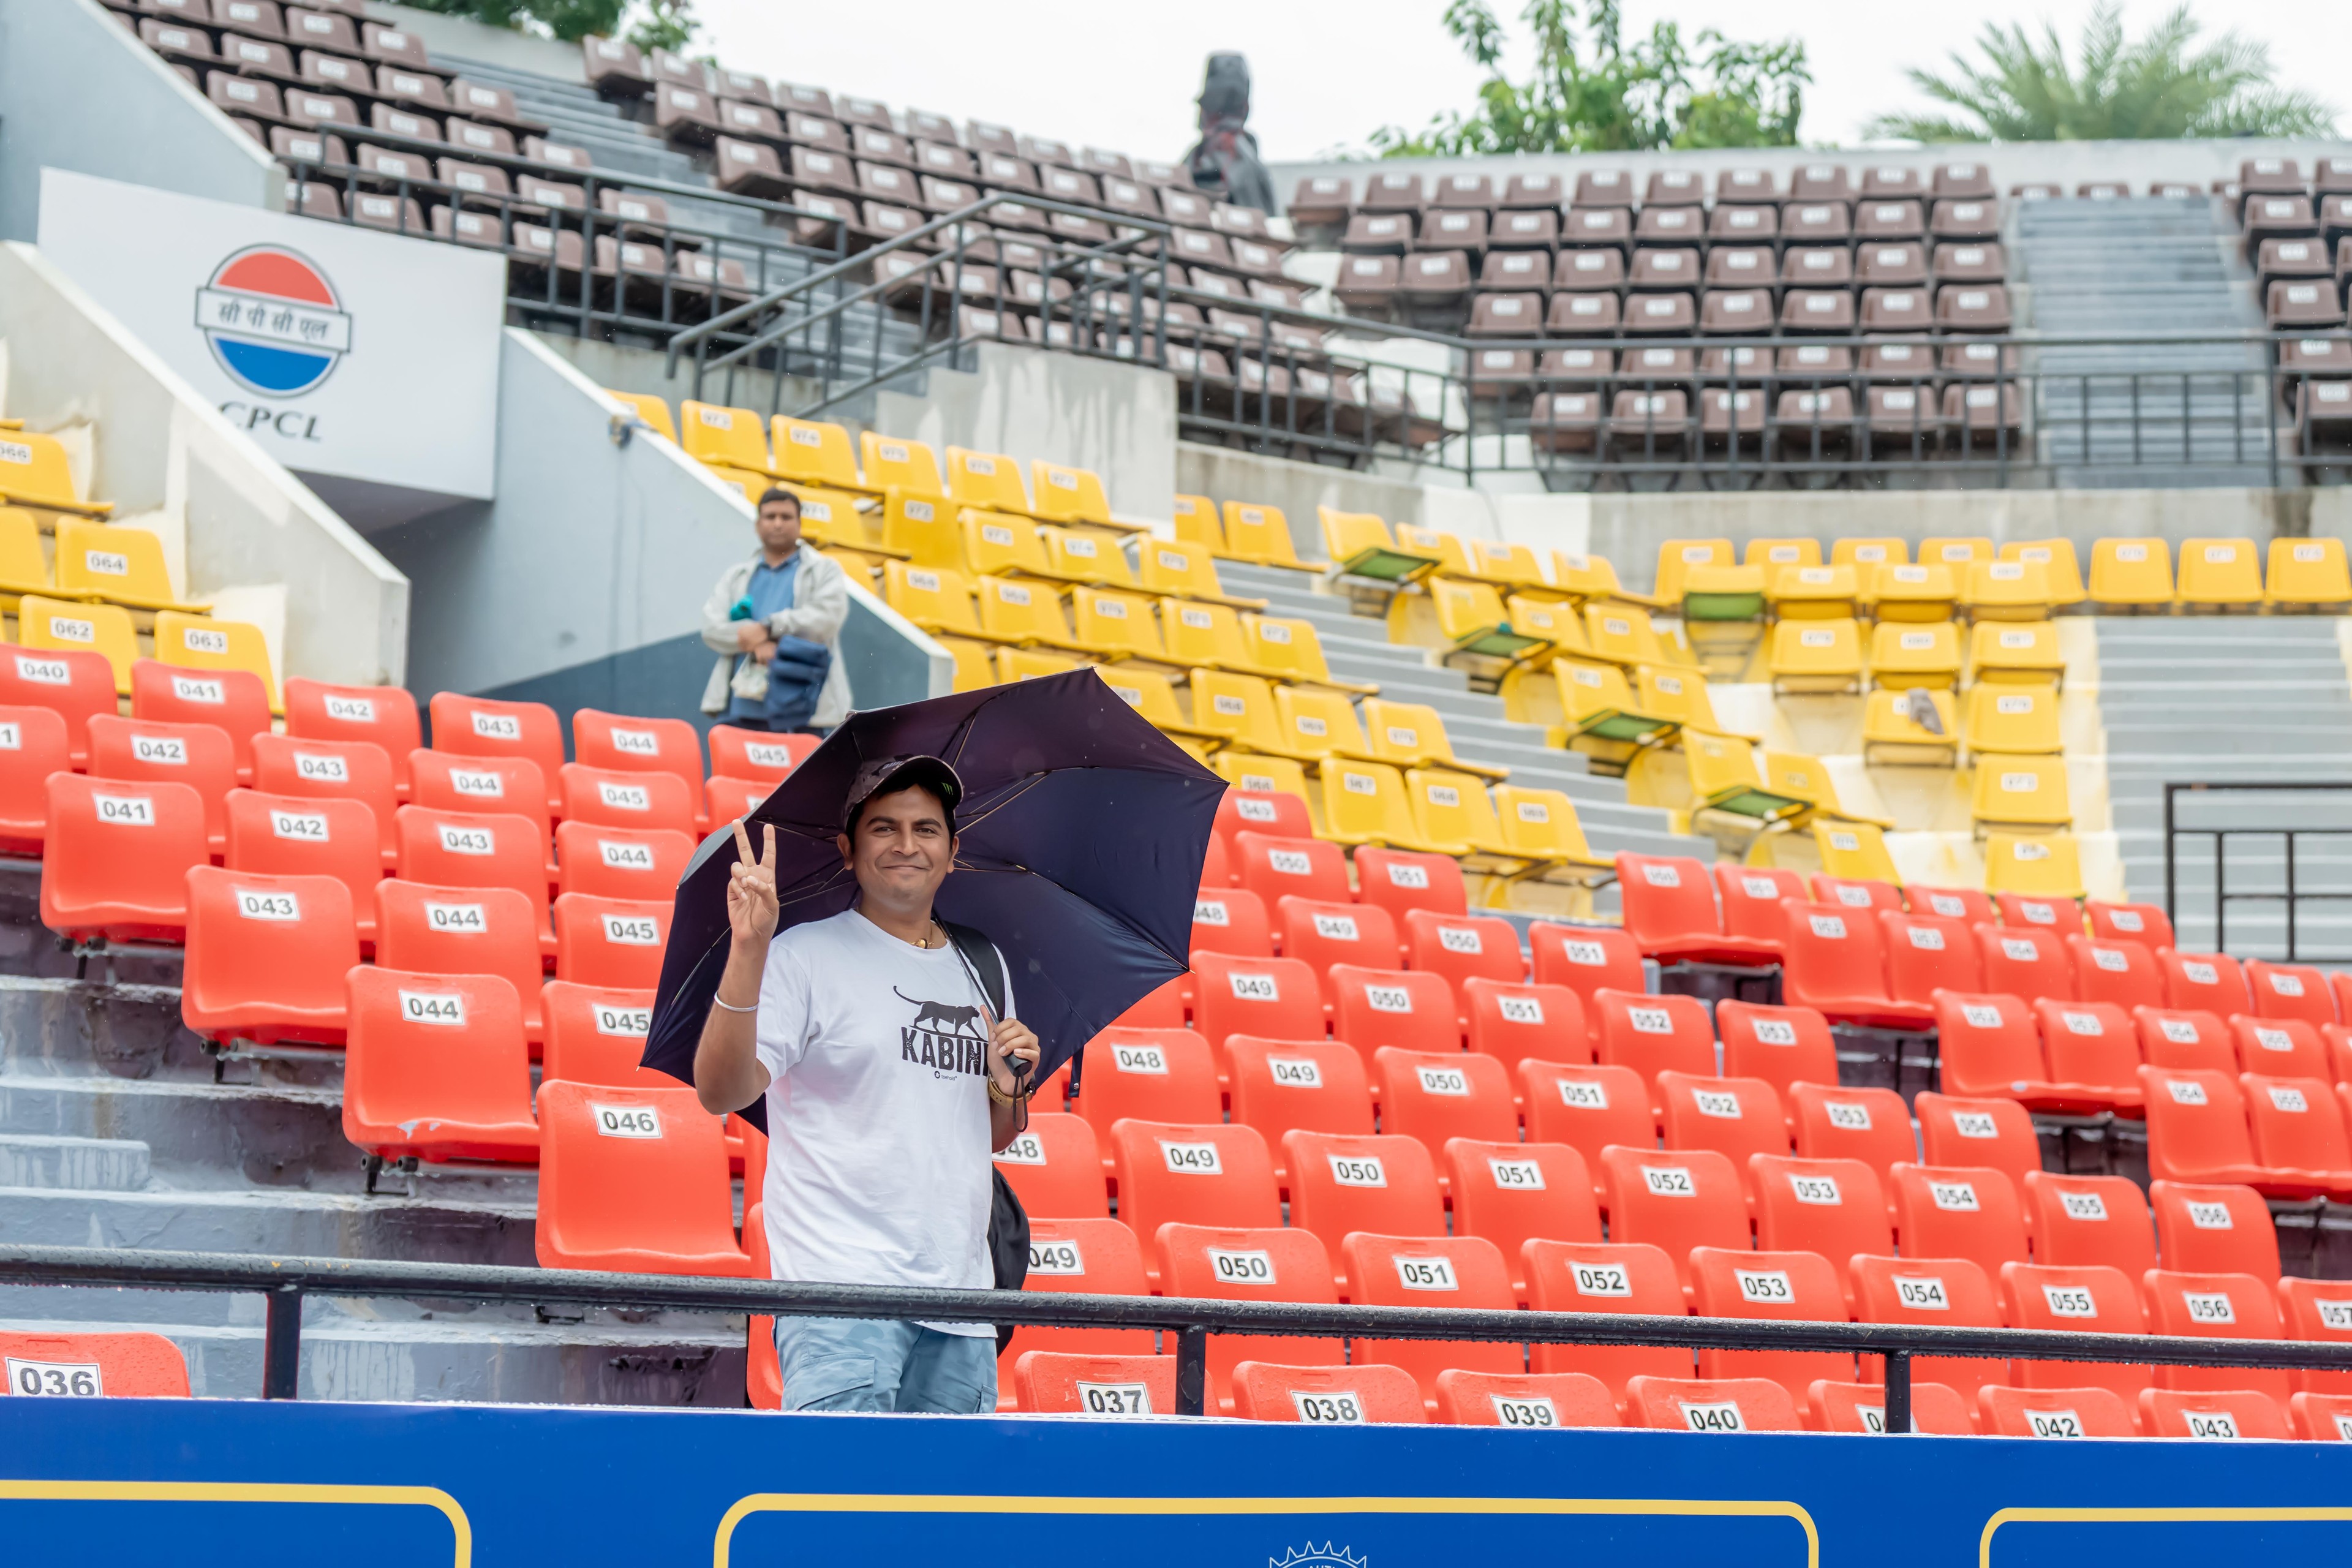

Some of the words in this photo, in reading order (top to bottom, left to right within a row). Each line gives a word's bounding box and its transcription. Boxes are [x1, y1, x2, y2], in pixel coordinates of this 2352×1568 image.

[219, 300, 240, 324] सी
[247, 304, 265, 328] पी
[271, 308, 293, 333] सी
[299, 317, 328, 339] एल
[91, 555, 123, 571] 064
[55, 622, 89, 638] 062
[189, 633, 224, 649] 063
[23, 663, 64, 680] 040
[179, 683, 217, 698] 041
[331, 701, 369, 717] 042
[478, 718, 514, 734] 043
[139, 742, 181, 759] 042
[617, 734, 652, 750] 044
[752, 748, 786, 764] 045
[302, 760, 342, 777] 043
[459, 776, 497, 791] 044
[606, 788, 644, 805] 045
[102, 801, 146, 820] 041
[279, 817, 323, 836] 042
[447, 832, 488, 850] 043
[608, 847, 648, 864] 044
[1393, 868, 1422, 883] 051
[245, 897, 293, 915] 043
[434, 909, 480, 927] 044
[610, 921, 654, 940] 045
[1320, 920, 1352, 935] 049
[1444, 932, 1477, 949] 050
[1569, 944, 1600, 960] 051
[1236, 978, 1272, 996] 049
[1372, 990, 1406, 1008] 050
[408, 998, 459, 1019] 044
[1504, 1001, 1537, 1019] 051
[602, 1012, 649, 1031] 045
[1635, 1013, 1667, 1030] 052
[1759, 1025, 1791, 1041] 053
[1119, 1050, 1161, 1068] 048
[1276, 1064, 1315, 1082] 049
[1424, 1072, 1462, 1090] 050
[1564, 1086, 1599, 1103] 051
[1702, 1098, 1736, 1114] 052
[602, 1111, 655, 1132] 046
[1832, 1108, 1866, 1126] 053
[1959, 1118, 1992, 1134] 054
[998, 1139, 1039, 1158] 48
[1170, 1148, 1214, 1167] 049
[1337, 1161, 1379, 1181] 050
[1498, 1166, 1536, 1184] 051
[1650, 1172, 1689, 1191] 052
[1797, 1181, 1834, 1199] 053
[1937, 1188, 1973, 1205] 054
[2067, 1198, 2101, 1215] 055
[2194, 1207, 2226, 1224] 056
[1029, 1247, 1076, 1269] 049
[1218, 1256, 1267, 1278] 050
[1403, 1264, 1448, 1284] 051
[1580, 1270, 1624, 1290] 052
[1744, 1277, 1787, 1297] 053
[1902, 1283, 1942, 1303] 054
[2051, 1292, 2090, 1311] 055
[2192, 1300, 2228, 1317] 056
[20, 1367, 95, 1396] 036
[1088, 1389, 1142, 1413] 037
[1303, 1398, 1358, 1422] 038
[1502, 1403, 1552, 1426] 039
[1691, 1409, 1738, 1430] 040
[2035, 1417, 2079, 1437] 042
[2193, 1418, 2233, 1438] 043
